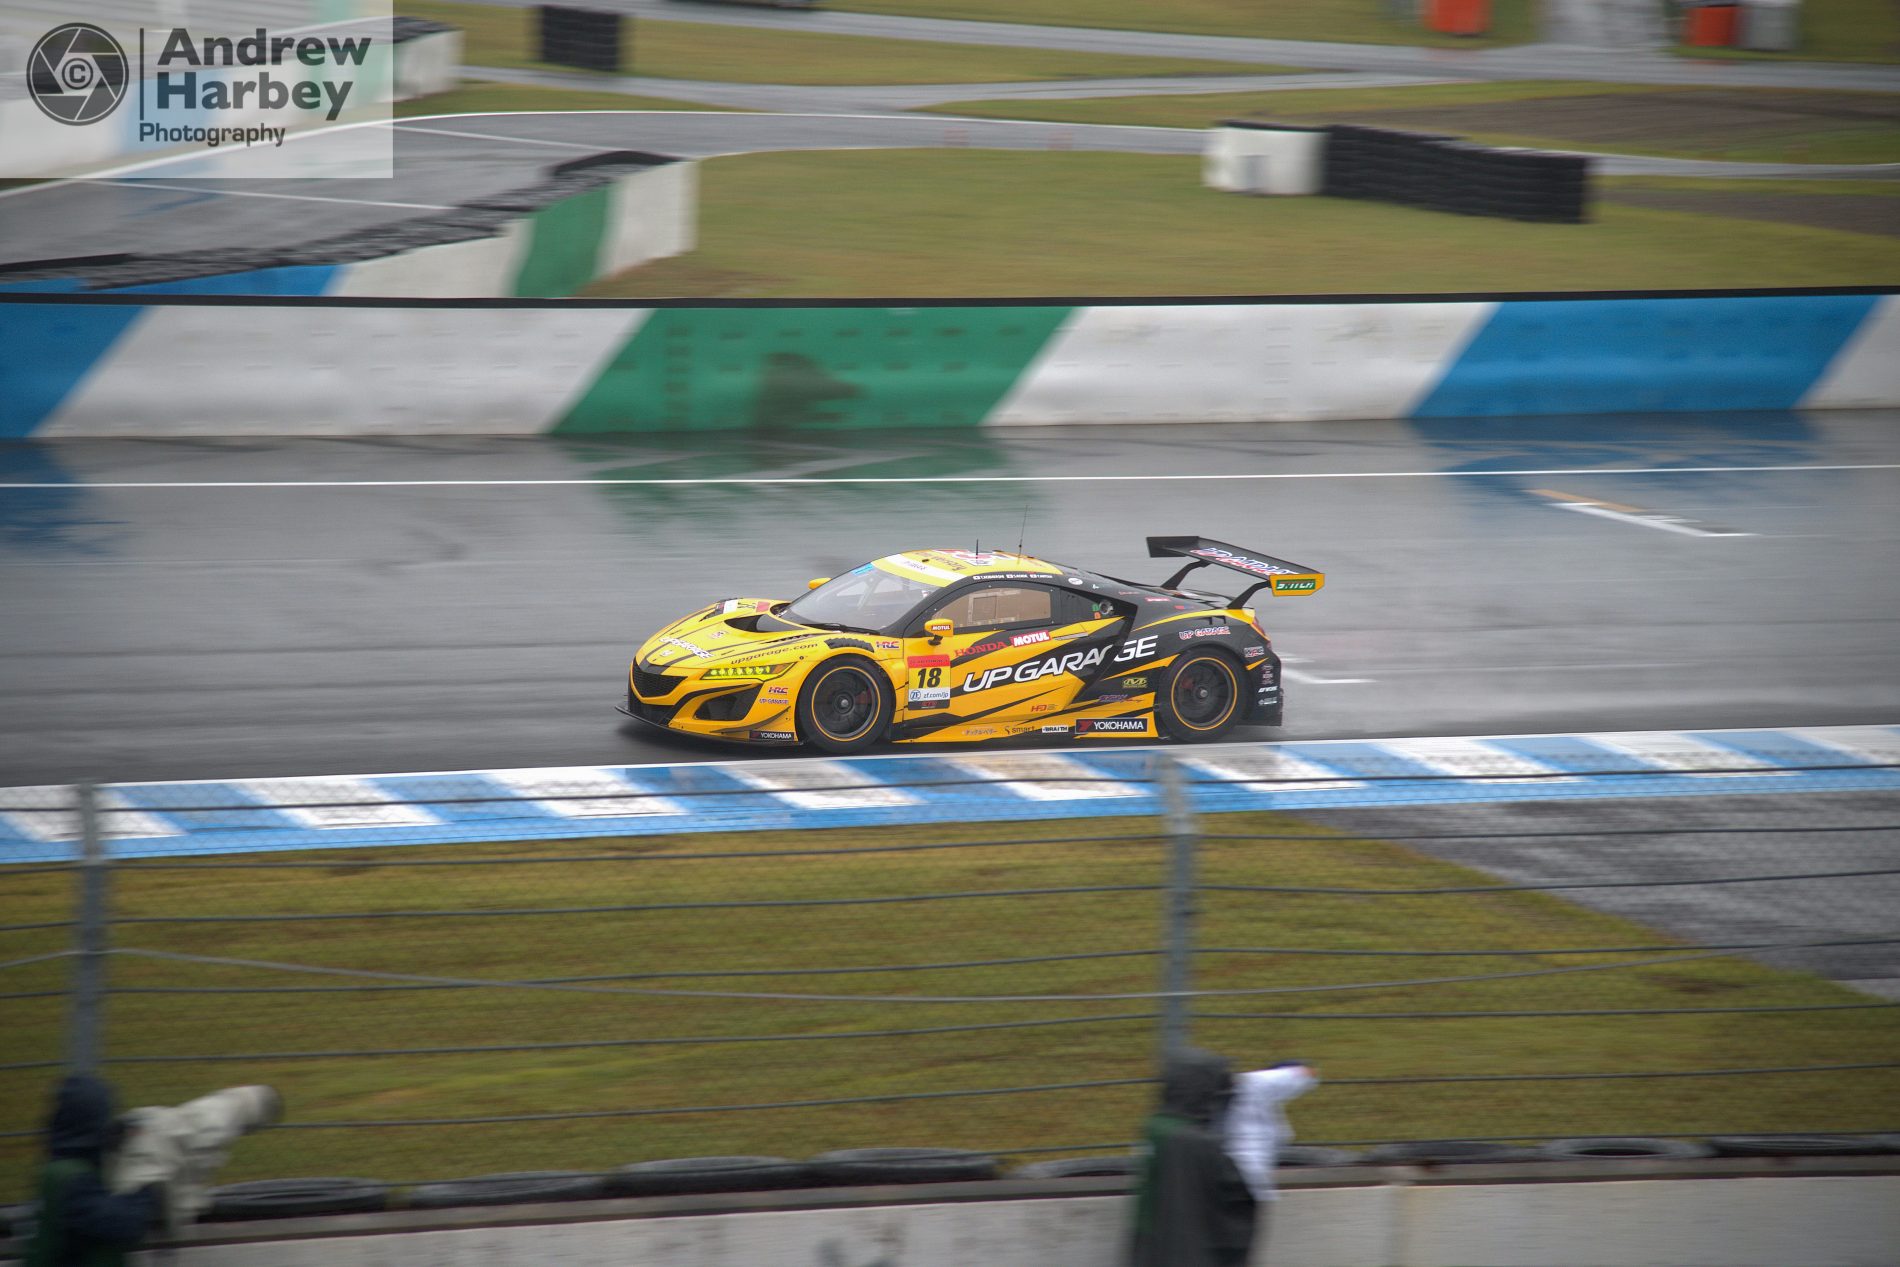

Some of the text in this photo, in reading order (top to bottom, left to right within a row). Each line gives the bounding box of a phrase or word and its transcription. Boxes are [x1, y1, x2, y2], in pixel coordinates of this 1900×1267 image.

[1013, 632, 1051, 647] MOTUL
[955, 641, 1007, 657] HONDA
[963, 634, 1159, 693] UP GARAGE
[917, 667, 943, 689] 18
[1093, 721, 1144, 730] YOKOHAMA
